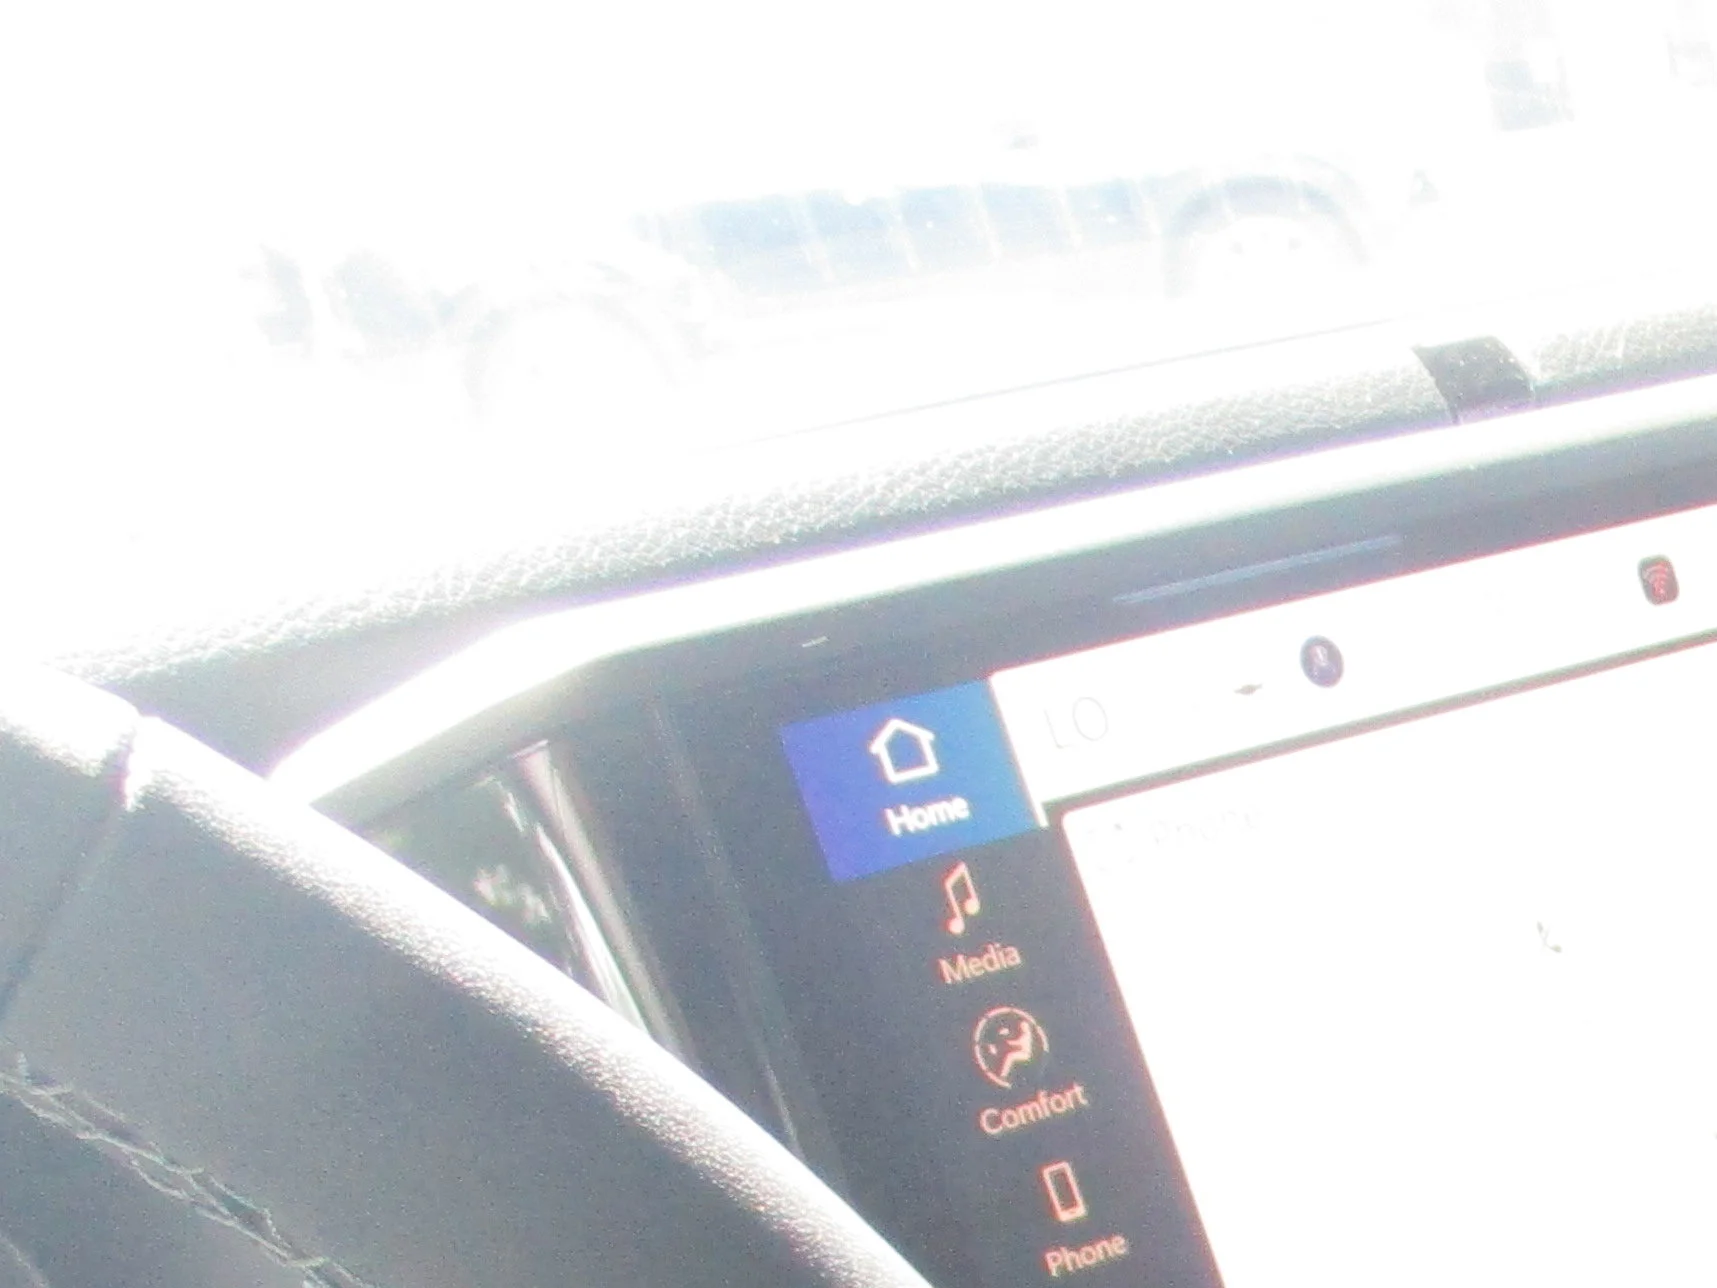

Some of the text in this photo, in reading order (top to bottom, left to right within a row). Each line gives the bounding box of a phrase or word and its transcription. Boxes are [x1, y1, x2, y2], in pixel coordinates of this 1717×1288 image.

[885, 797, 970, 836] Home
[937, 942, 1022, 985] Media
[980, 1082, 1089, 1136] Comfort
[1043, 1234, 1129, 1278] Phone
